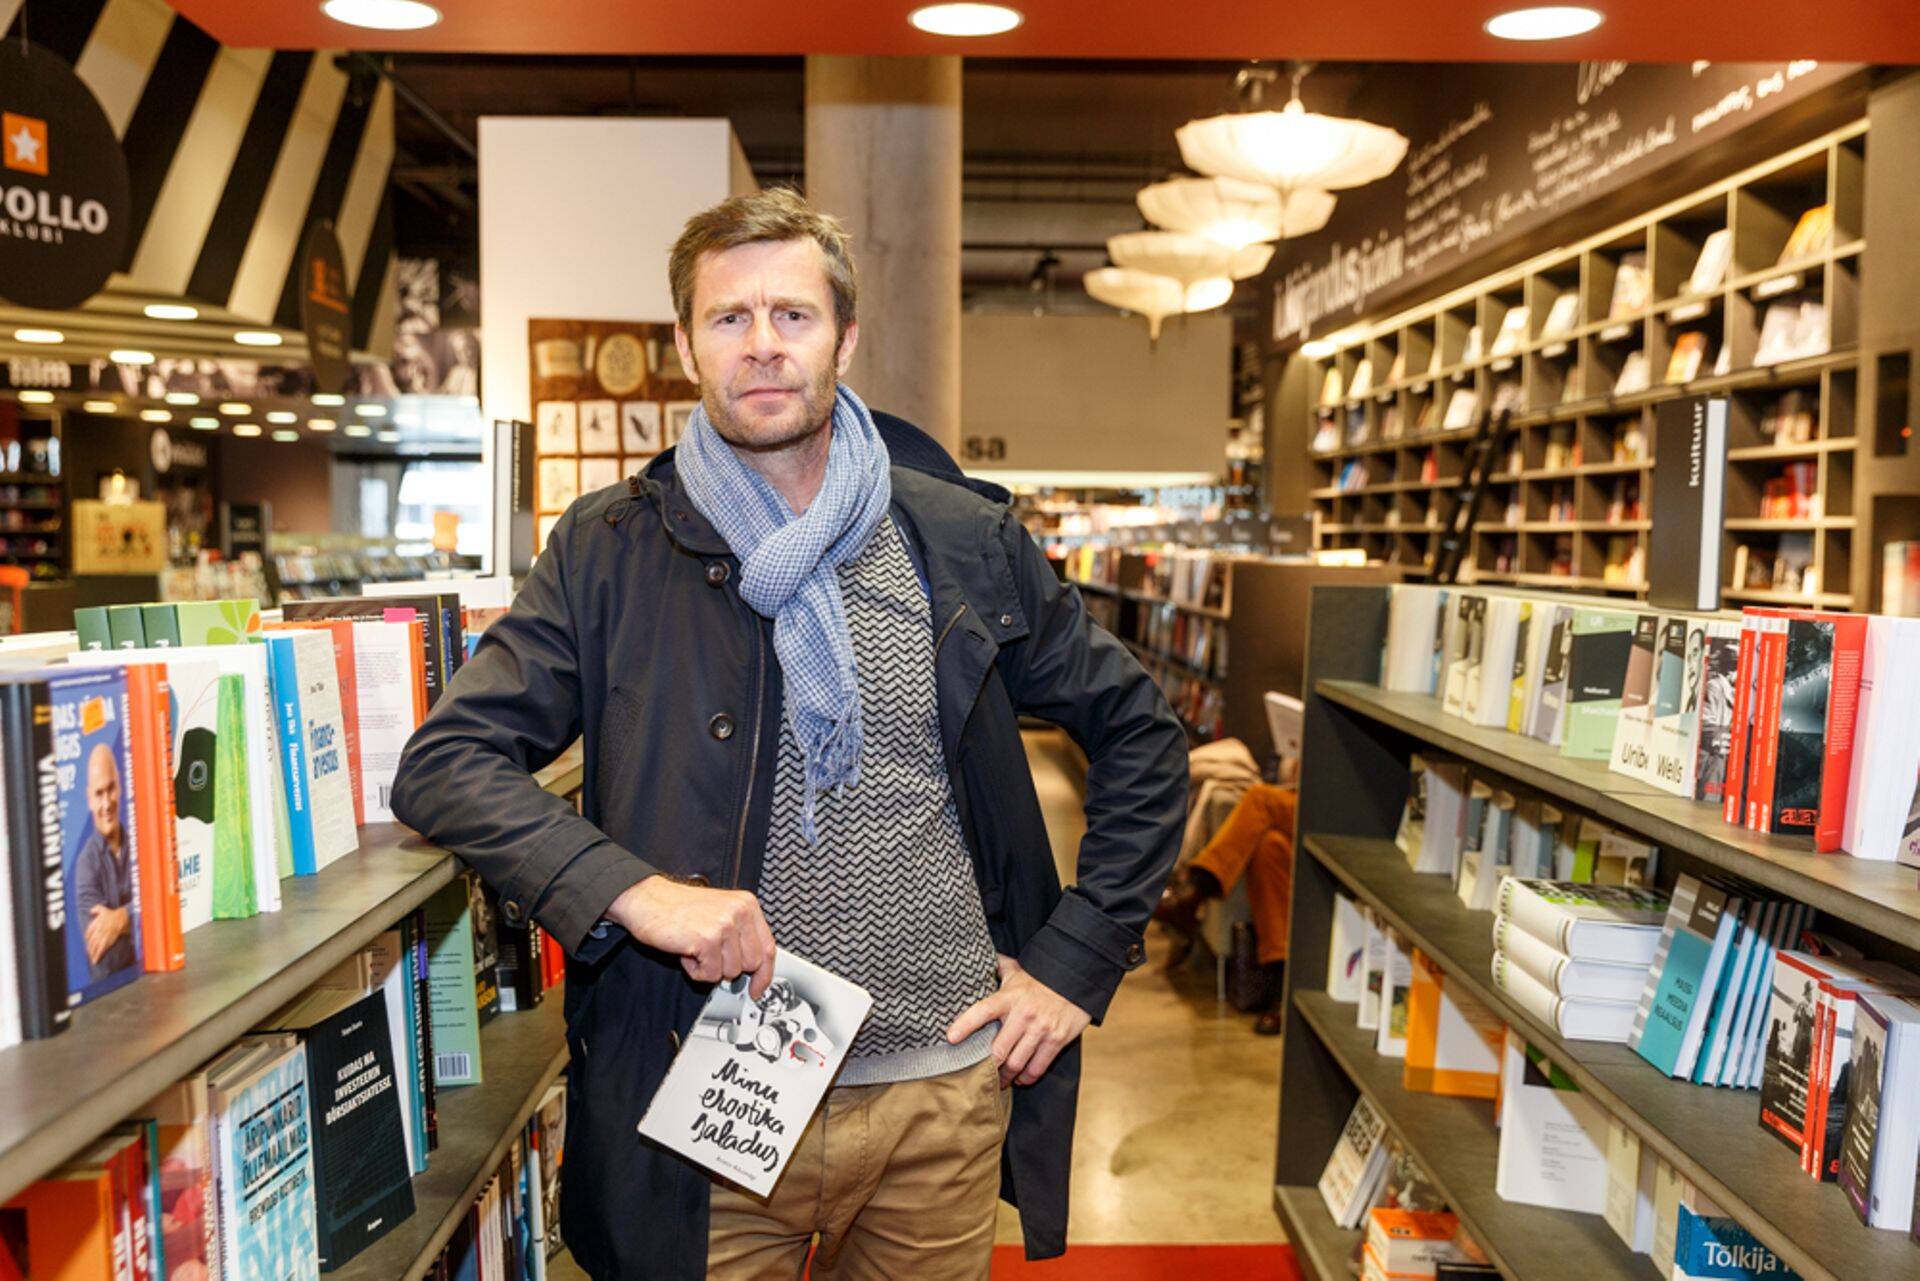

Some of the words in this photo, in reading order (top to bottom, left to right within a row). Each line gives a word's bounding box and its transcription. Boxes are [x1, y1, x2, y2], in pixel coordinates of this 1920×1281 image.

[0, 184, 109, 235] OLLO
[1689, 402, 1704, 487] kultuur
[1656, 753, 1683, 784] Wells
[711, 1057, 780, 1105] Minu
[699, 1087, 785, 1136] erootika
[1703, 1240, 1777, 1276] Tõlkija
